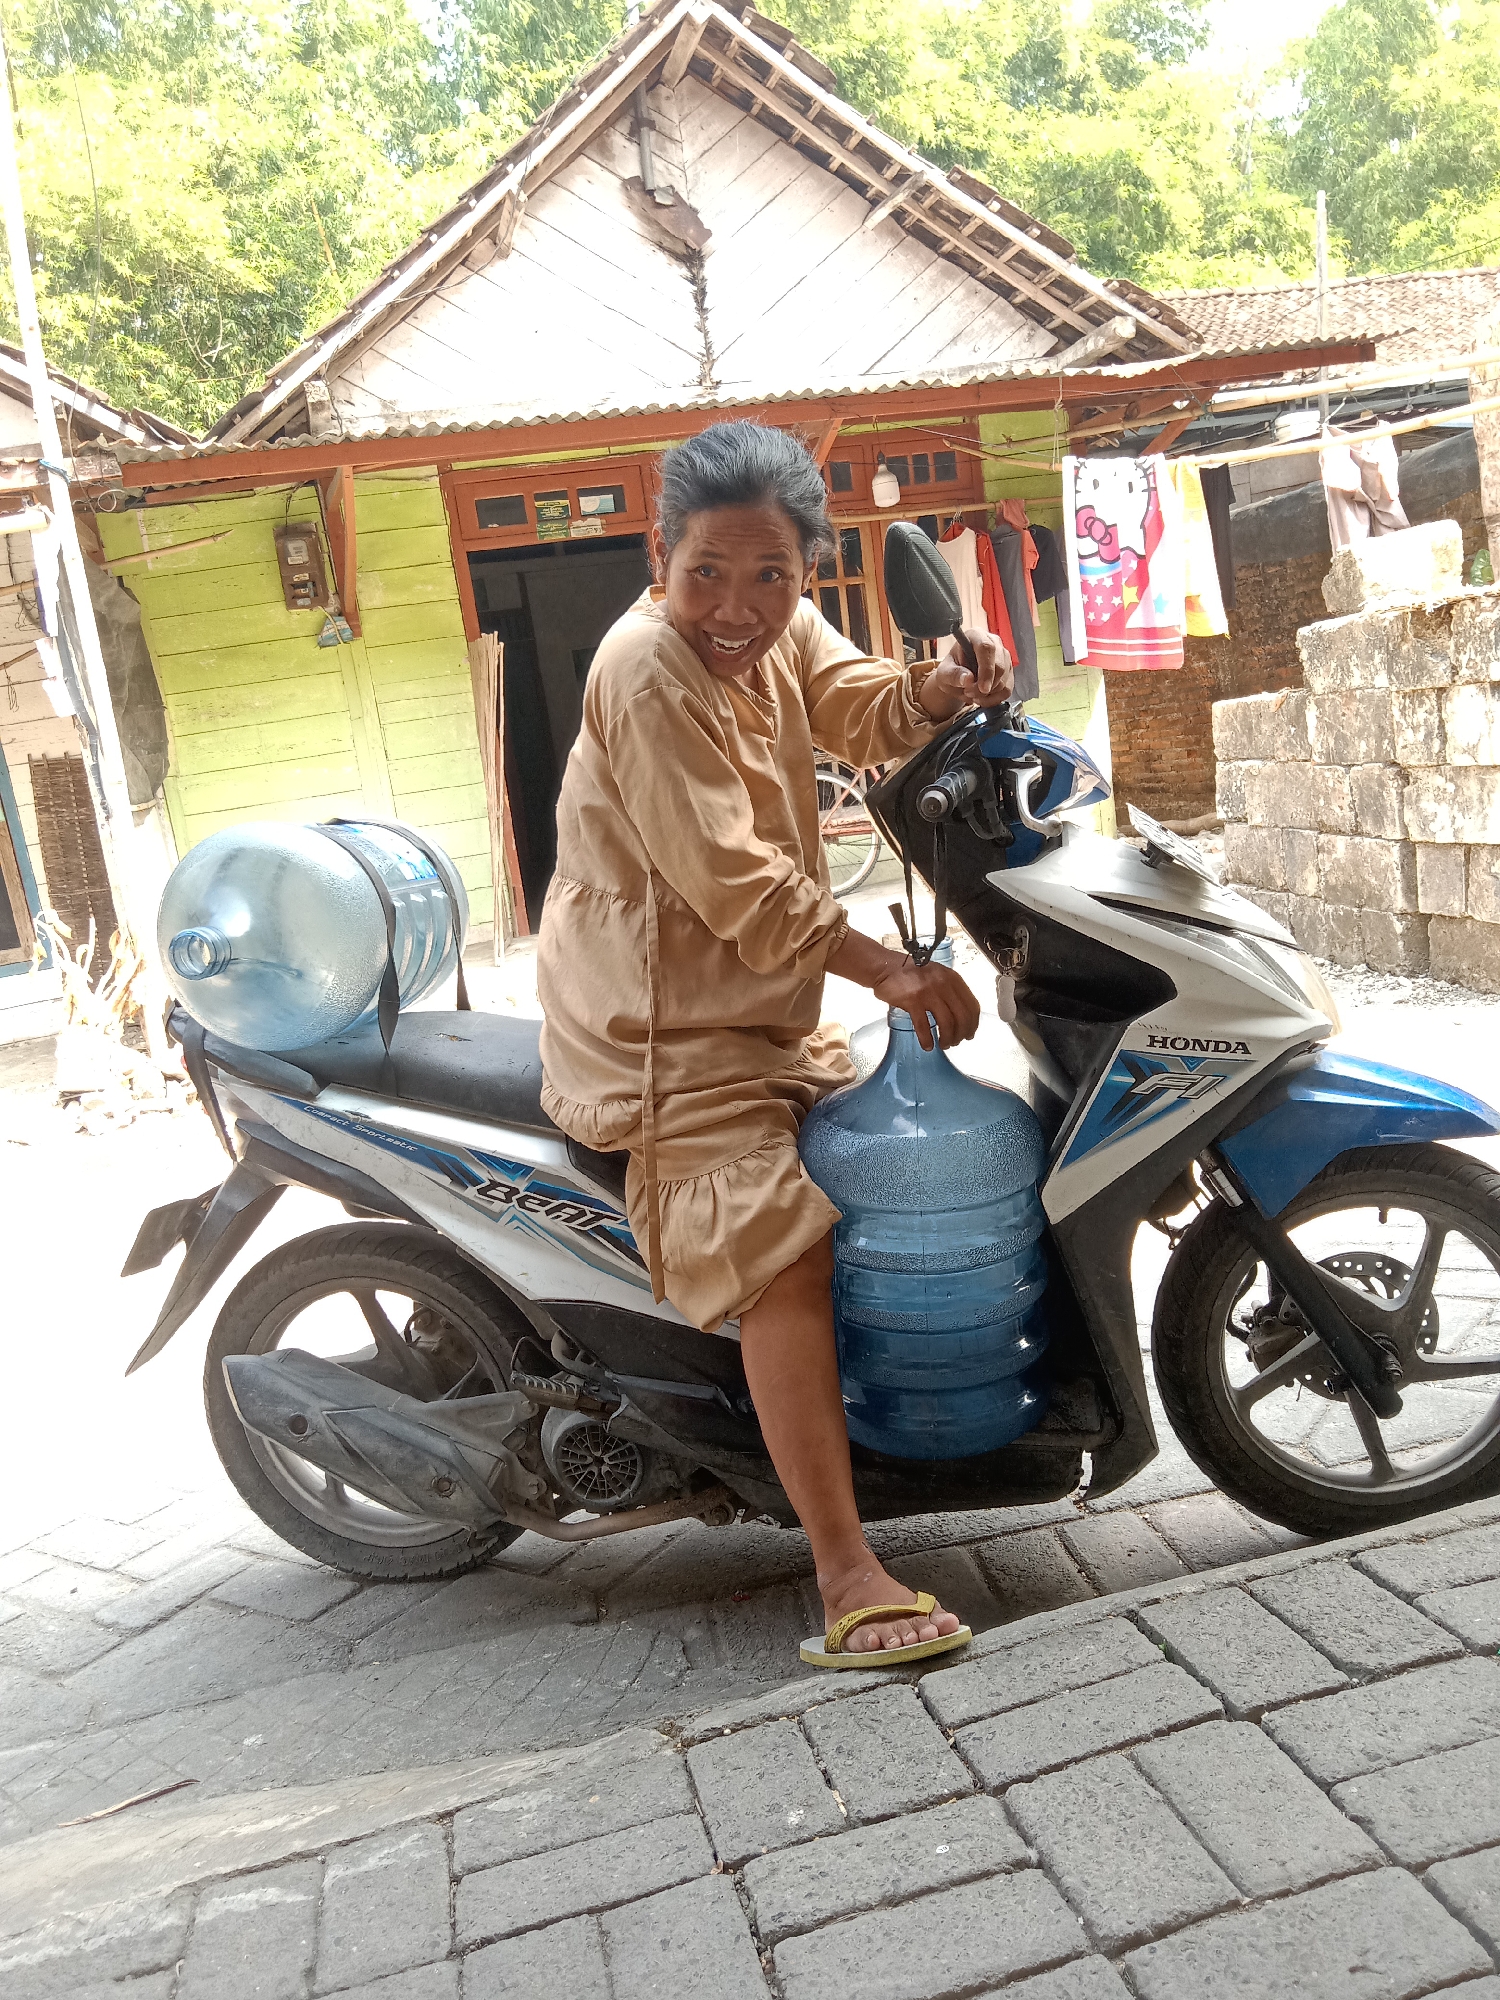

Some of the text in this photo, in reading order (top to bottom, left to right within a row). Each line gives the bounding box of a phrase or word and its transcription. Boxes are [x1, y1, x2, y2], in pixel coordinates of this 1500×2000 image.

[1147, 1034, 1252, 1055] HONDA
[1131, 1072, 1227, 1099] FI
[303, 1105, 350, 1126] Compact
